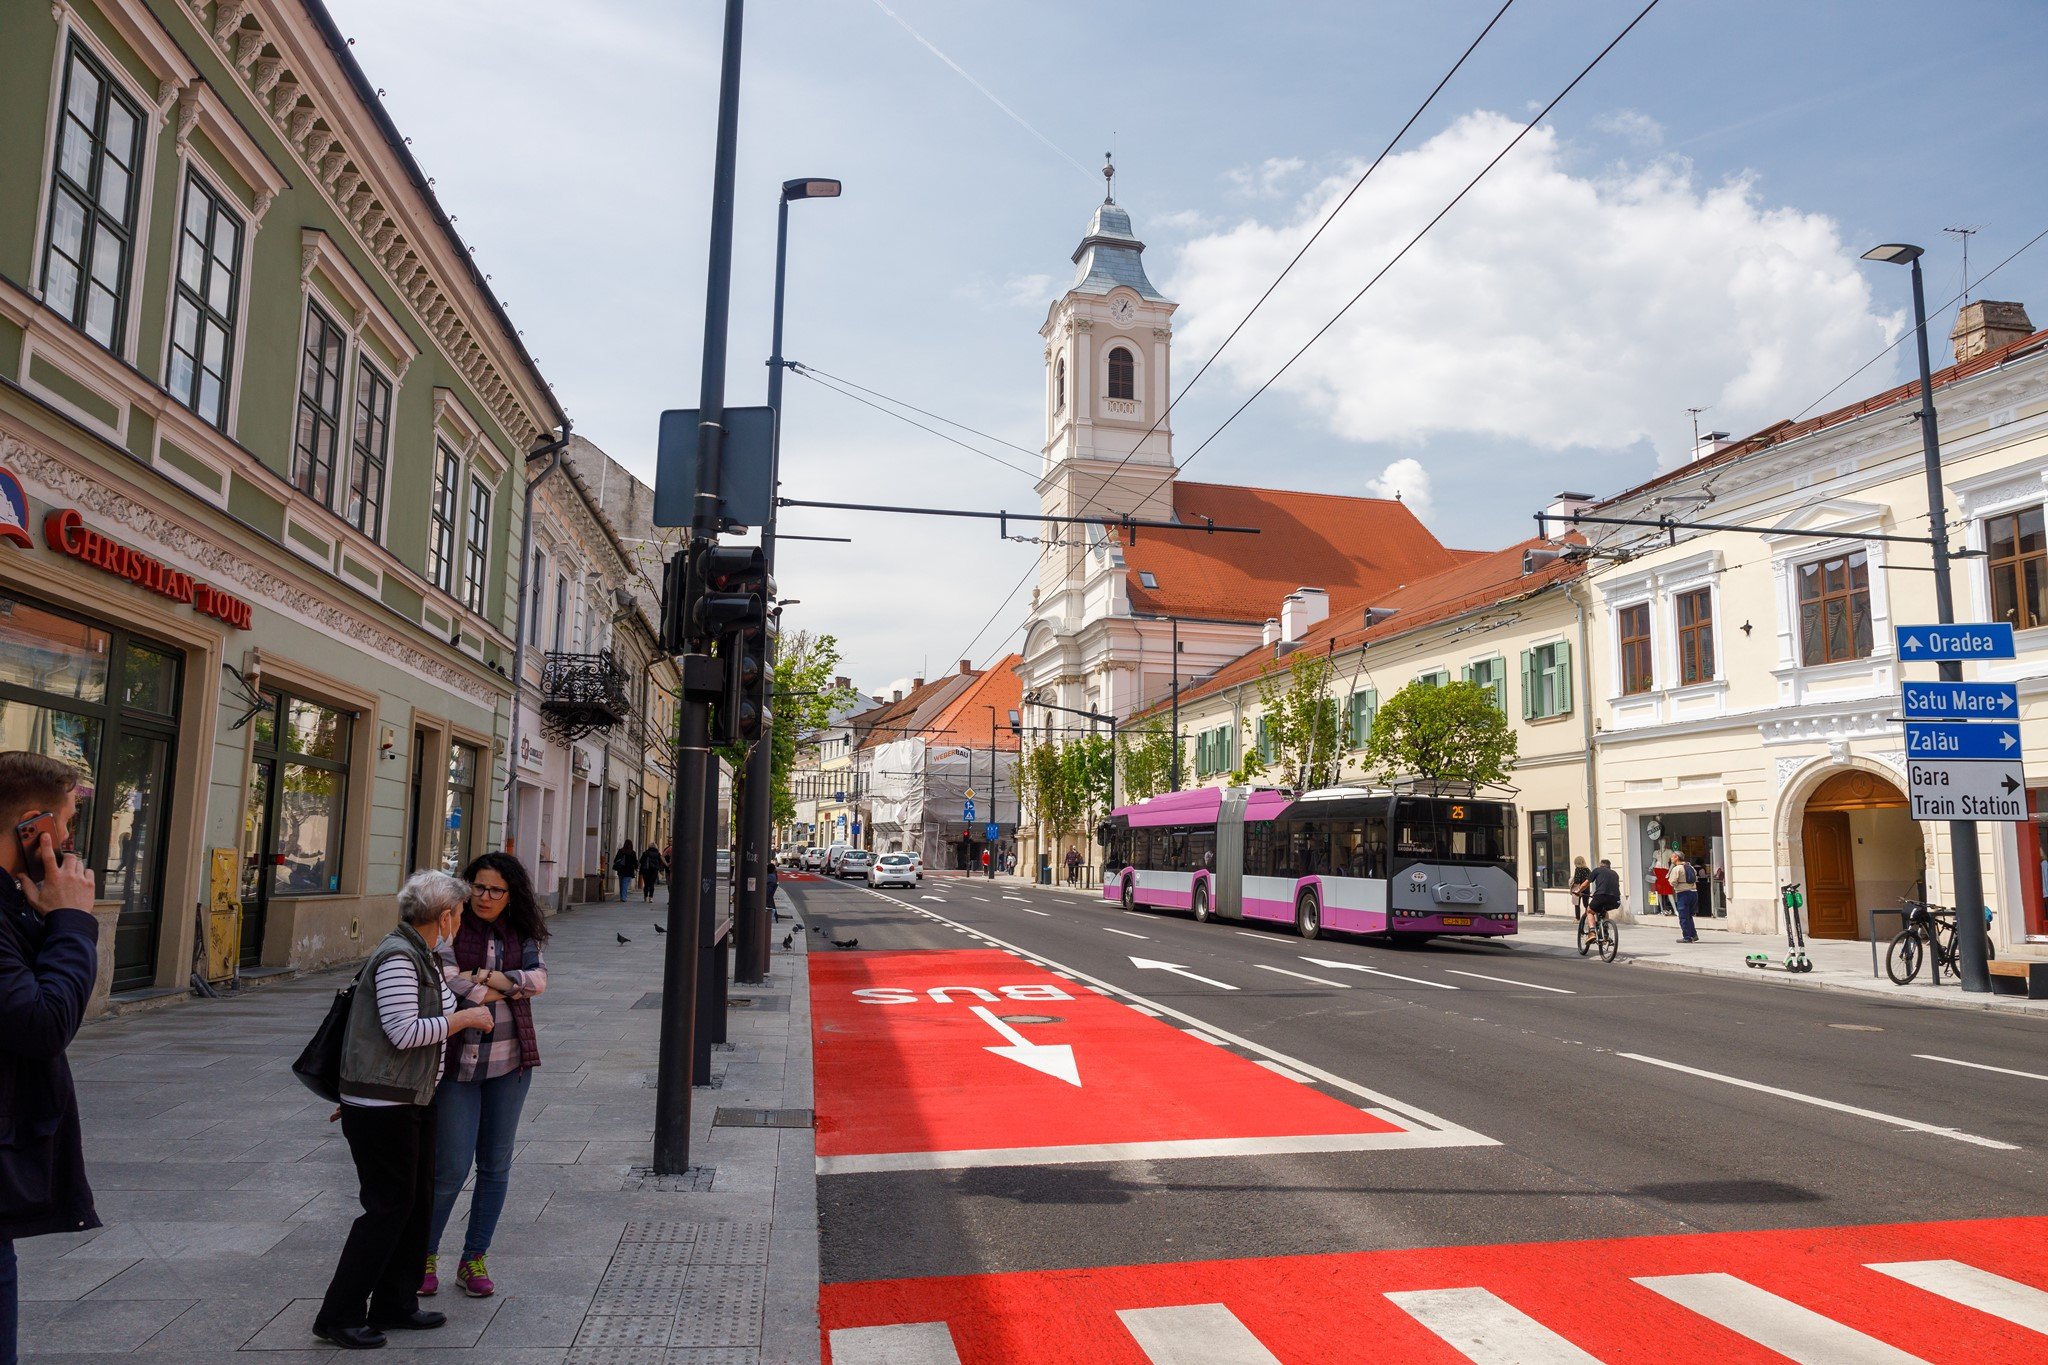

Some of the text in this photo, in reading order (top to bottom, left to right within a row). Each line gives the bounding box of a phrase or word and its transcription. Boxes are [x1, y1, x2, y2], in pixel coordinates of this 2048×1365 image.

[45, 508, 253, 631] CHRISTIAN TOUR
[1929, 632, 1994, 653] Oradea
[1907, 689, 1996, 711] Satu Mare
[1909, 730, 1959, 751] Zalău
[933, 748, 969, 762] WEBERBAU
[1911, 766, 1950, 786] Gara
[1452, 805, 1464, 819] 25
[1914, 795, 2020, 816] Train Station
[1409, 883, 1426, 893] 311
[852, 984, 1077, 1005] BUS
